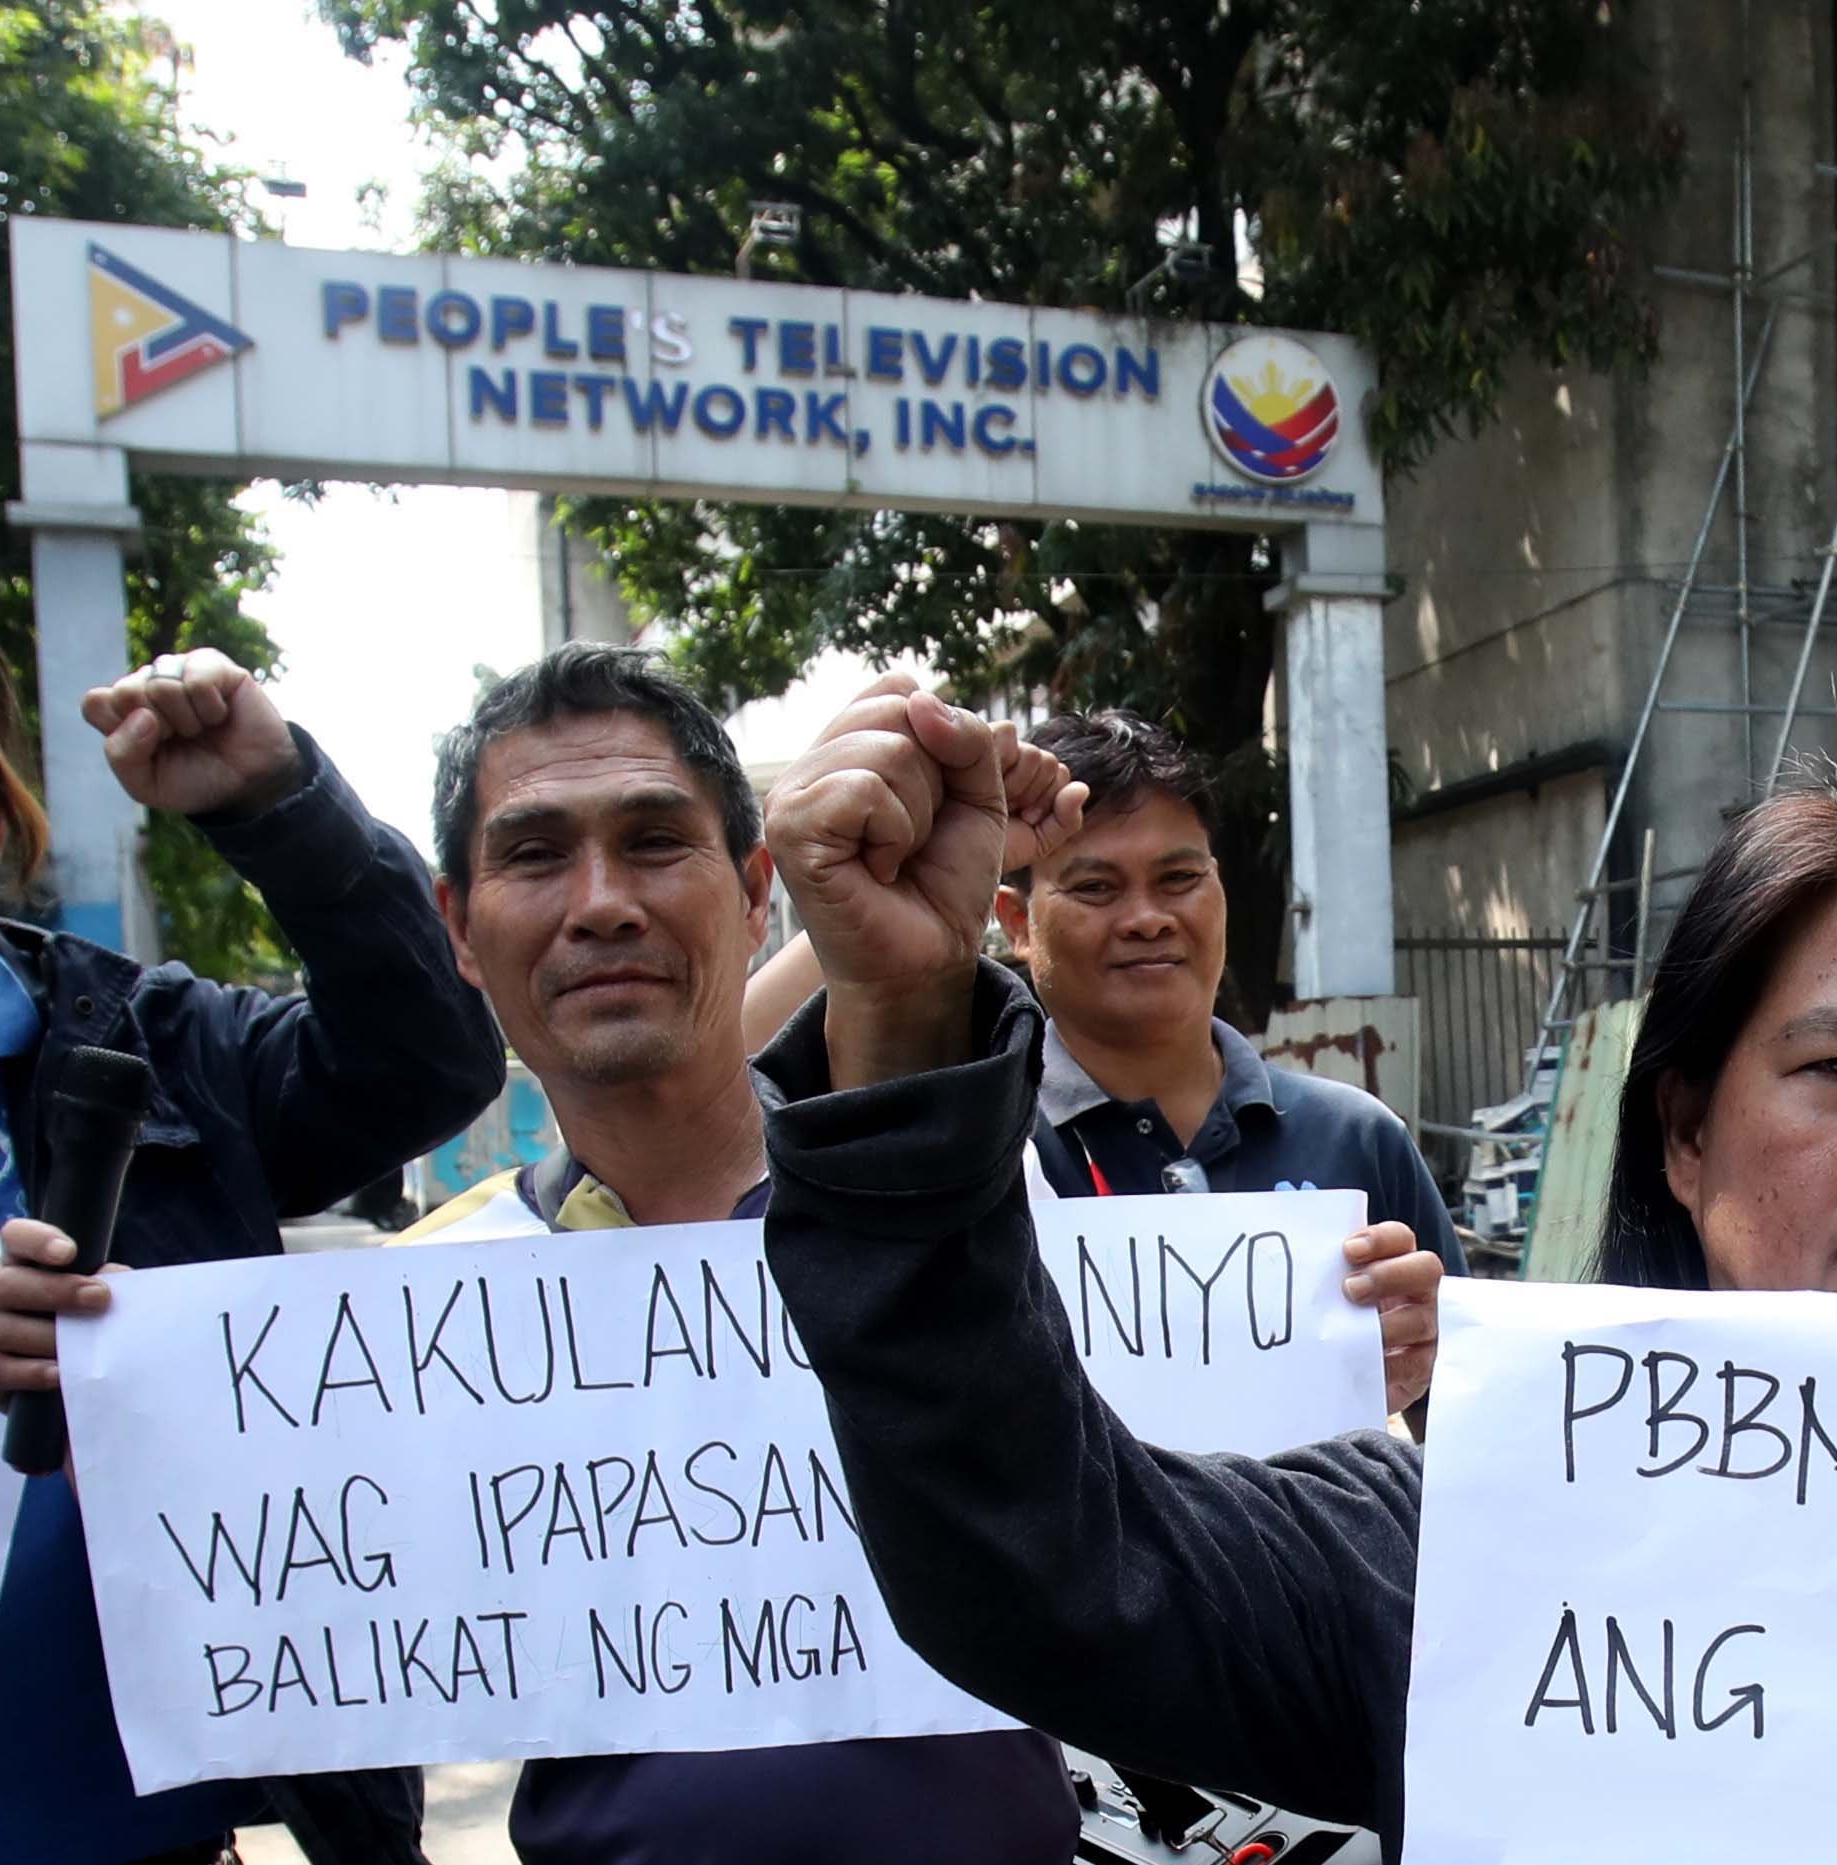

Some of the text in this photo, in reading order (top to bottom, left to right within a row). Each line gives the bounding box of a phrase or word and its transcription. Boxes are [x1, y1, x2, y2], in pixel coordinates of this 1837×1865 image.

[322, 281, 1161, 400] PEOPLE'S TELEVISION
[468, 367, 1037, 456] NETWORK, INC.
[1077, 1231, 1294, 1365] NIYO
[158, 1475, 397, 1607] WAG
[204, 1593, 867, 1717] BALIKAT NG MGA
[1524, 1603, 1767, 1741] ANG
